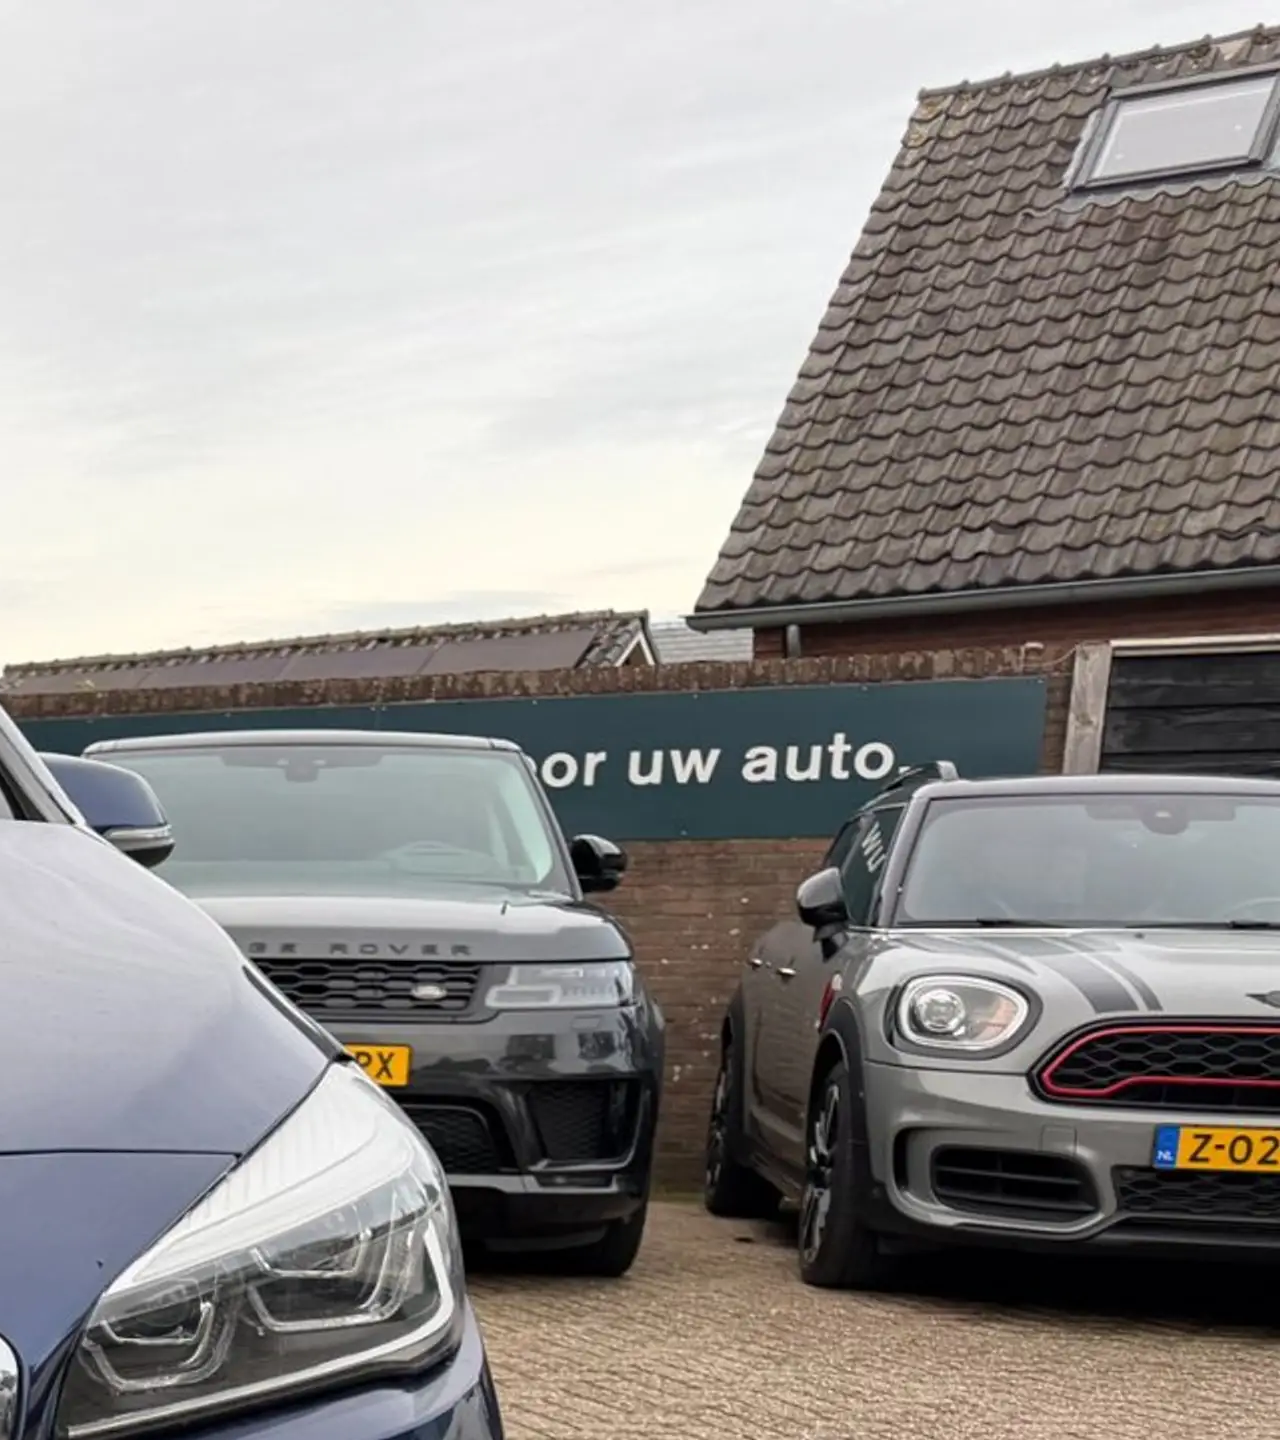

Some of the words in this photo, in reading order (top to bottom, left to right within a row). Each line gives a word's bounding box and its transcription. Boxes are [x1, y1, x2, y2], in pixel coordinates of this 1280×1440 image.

[628, 748, 721, 785] uw
[741, 732, 911, 784] auto.
[329, 942, 472, 956] ROVER
